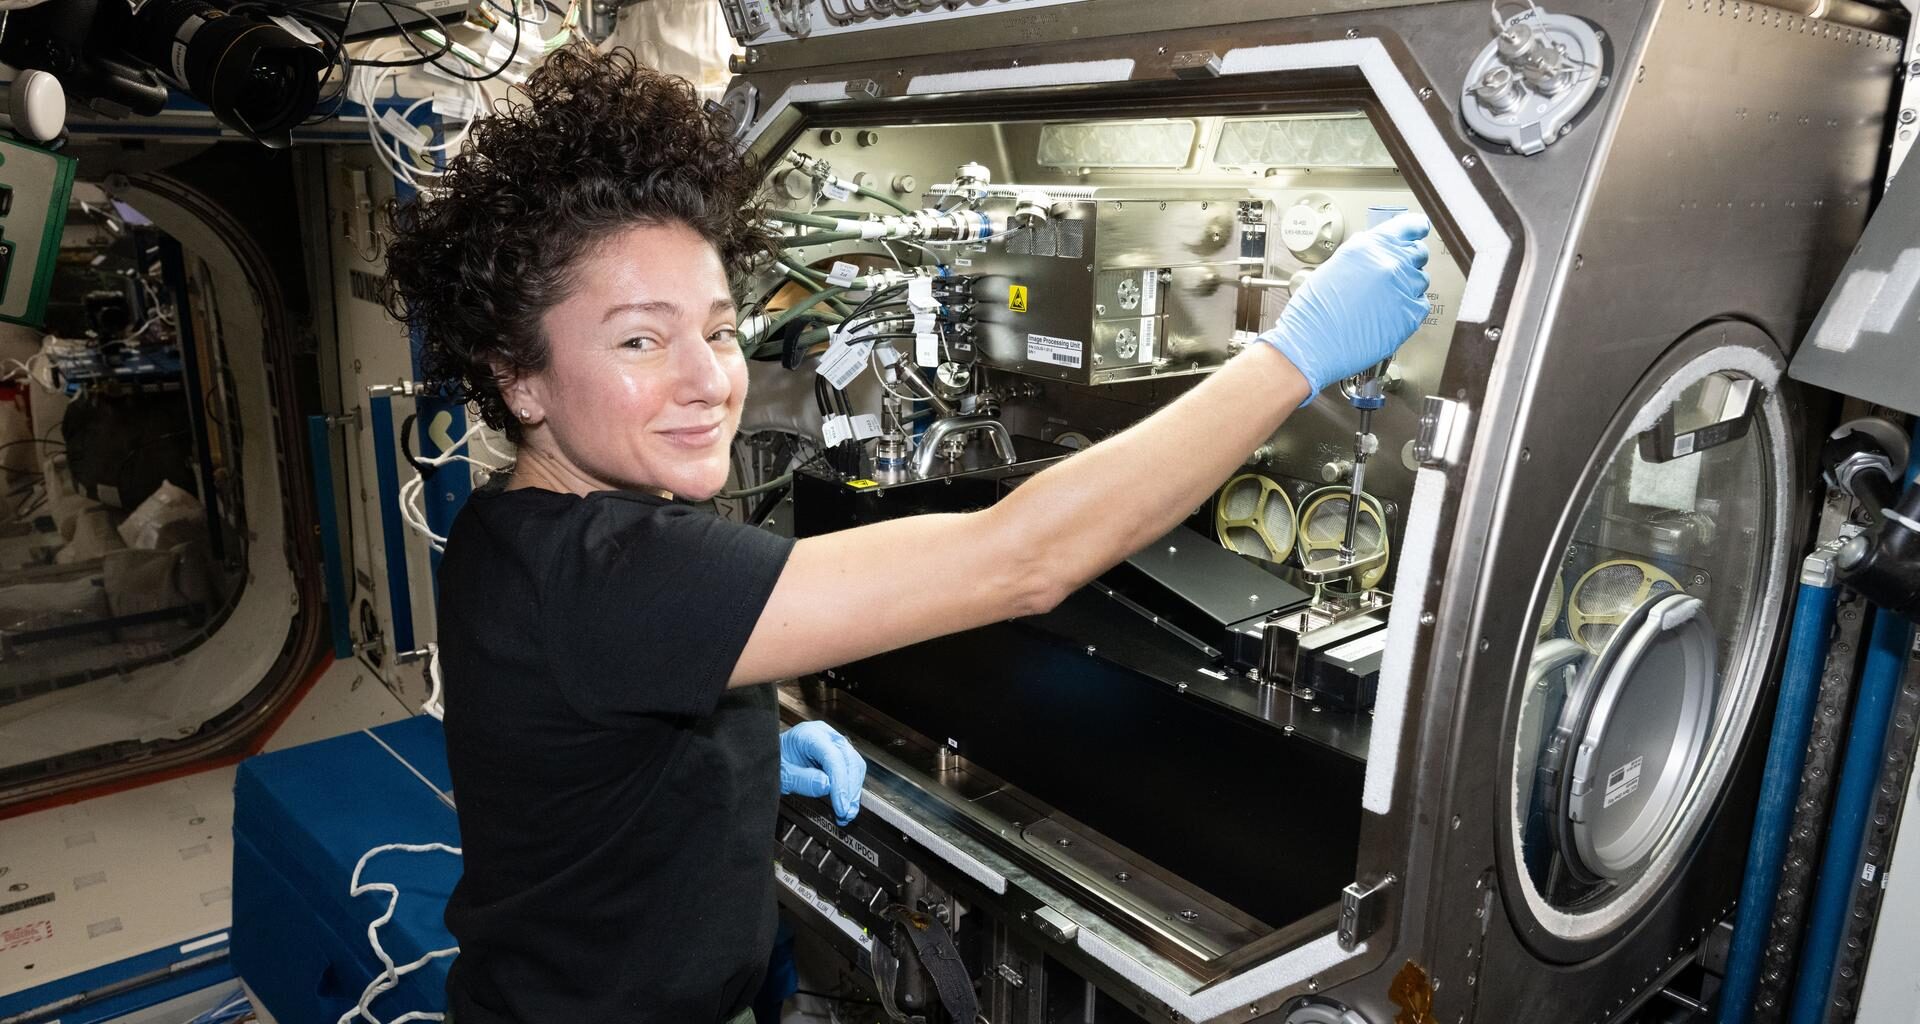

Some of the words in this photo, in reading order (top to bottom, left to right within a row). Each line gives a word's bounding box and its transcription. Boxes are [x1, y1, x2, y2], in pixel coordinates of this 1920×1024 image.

[1028, 336, 1042, 344] Image
[1043, 337, 1069, 349] Processing
[855, 842, 875, 862] (PDC)
